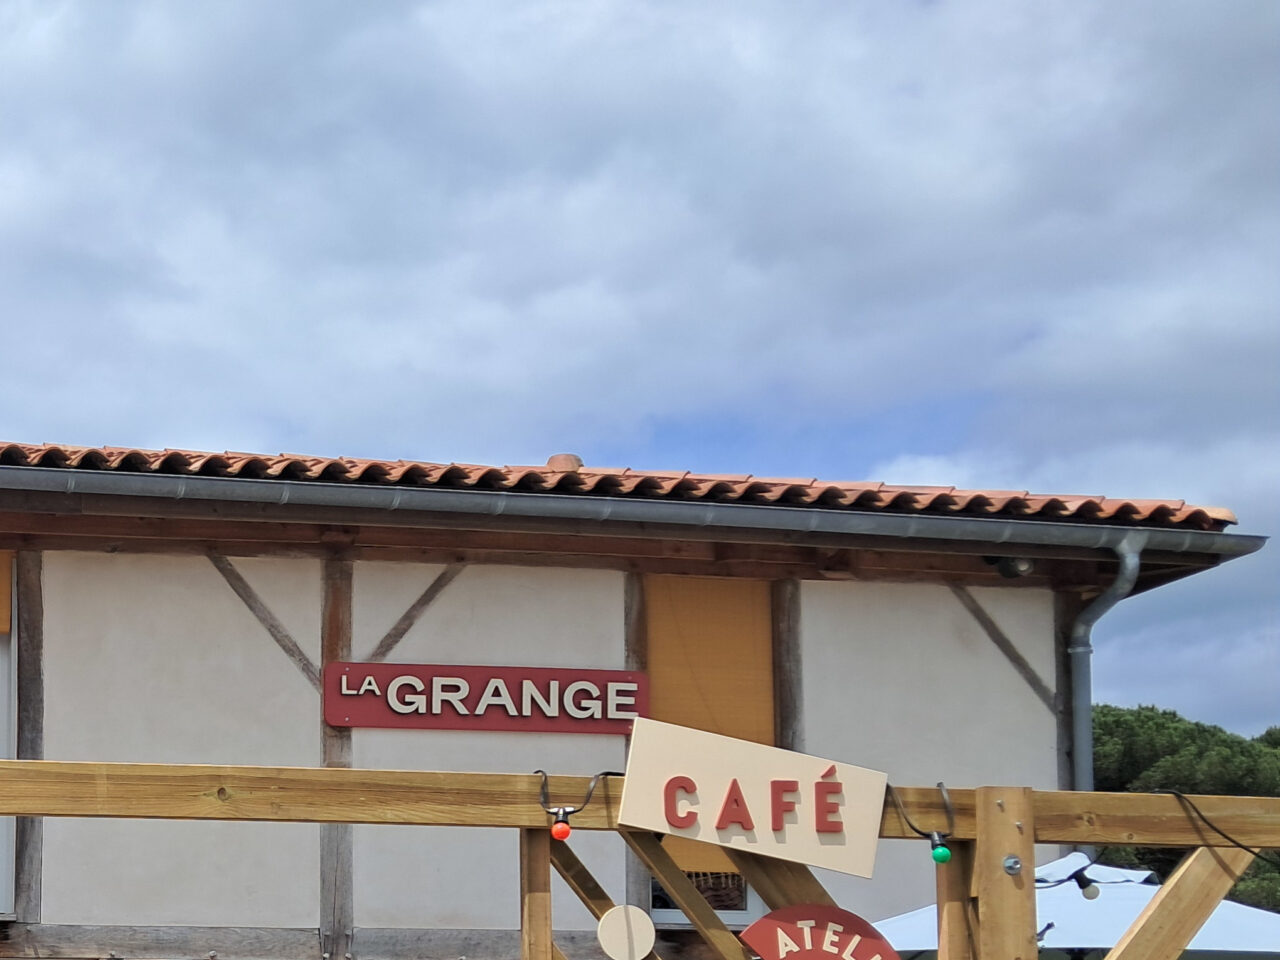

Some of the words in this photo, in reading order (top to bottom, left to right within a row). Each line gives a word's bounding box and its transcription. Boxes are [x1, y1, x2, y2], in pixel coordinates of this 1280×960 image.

[340, 674, 381, 696] LA
[387, 675, 639, 720] GRANGE
[663, 764, 844, 833] CAFÉ
